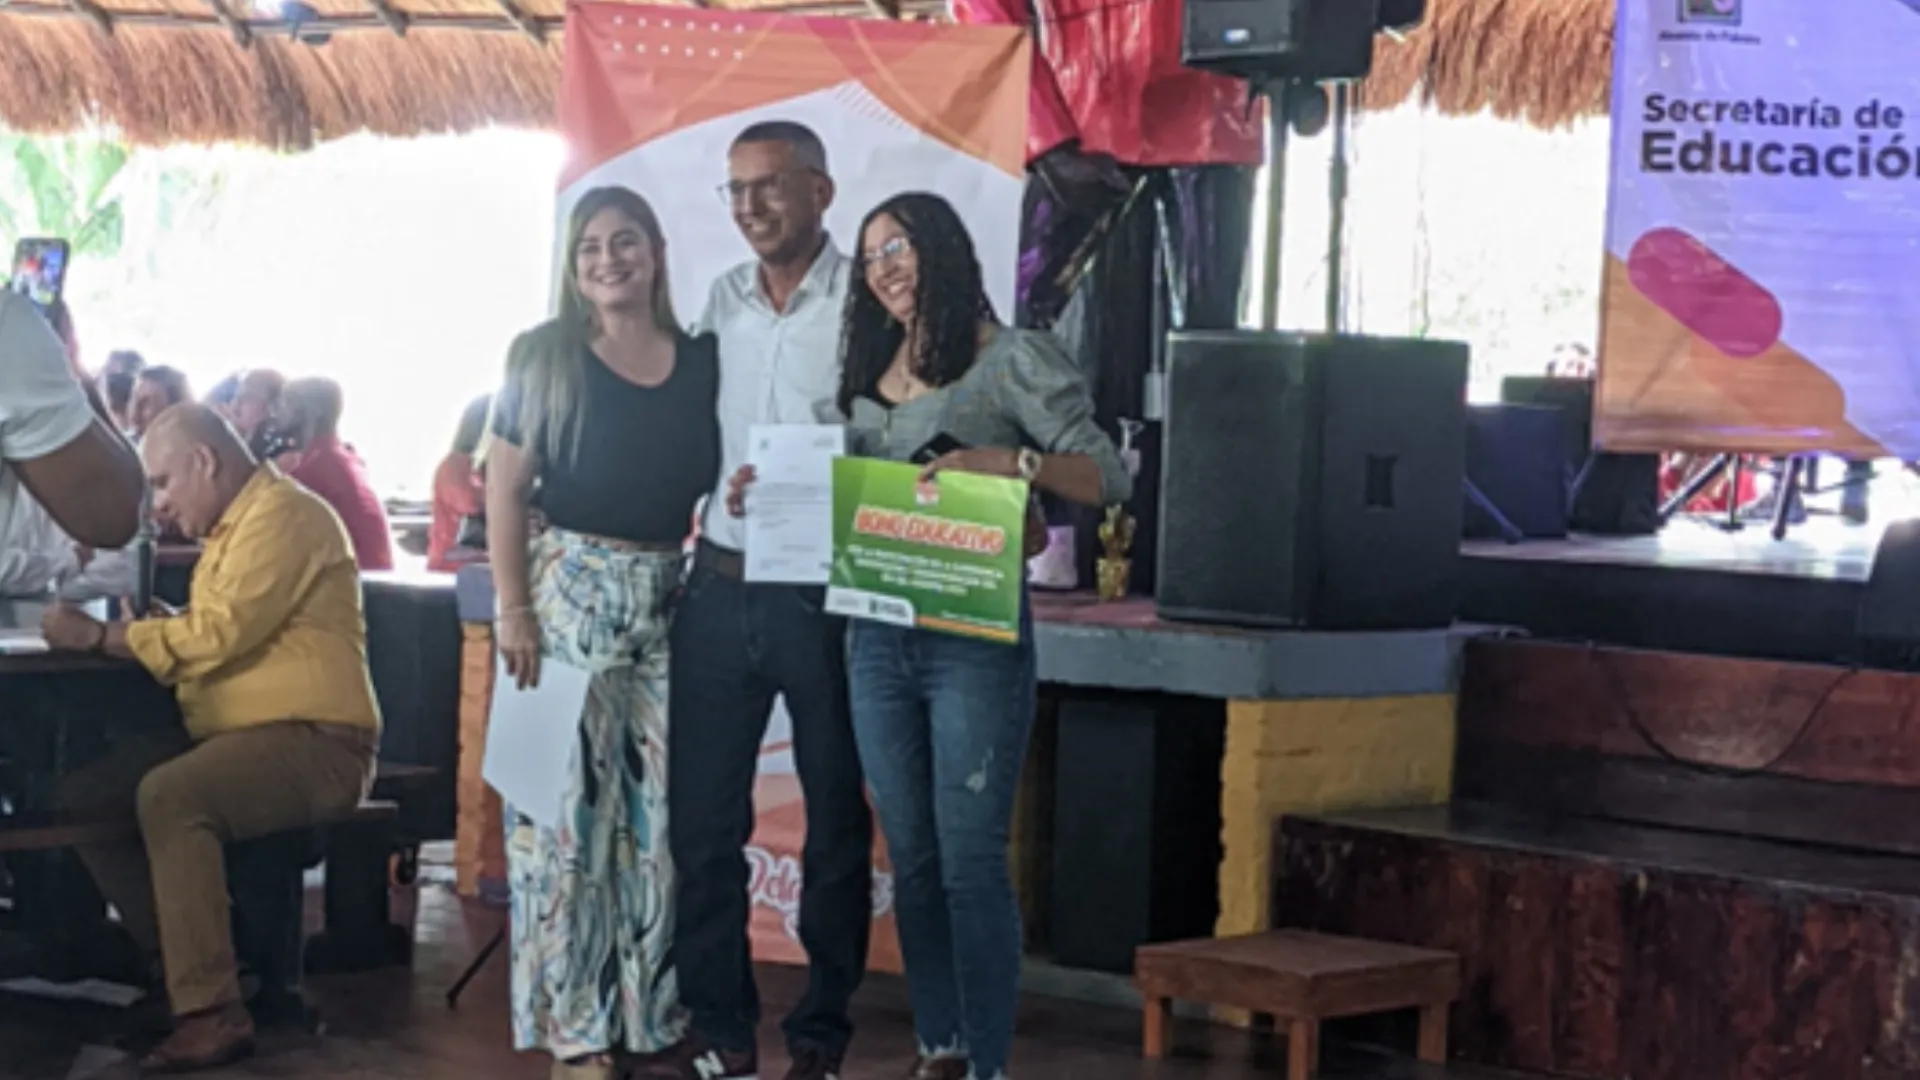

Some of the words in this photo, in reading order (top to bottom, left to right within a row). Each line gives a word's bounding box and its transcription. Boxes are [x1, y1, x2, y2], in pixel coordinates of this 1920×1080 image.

[1643, 93, 1841, 127] Secretaría
[1854, 99, 1904, 129] de
[1640, 130, 1920, 179] Educació
